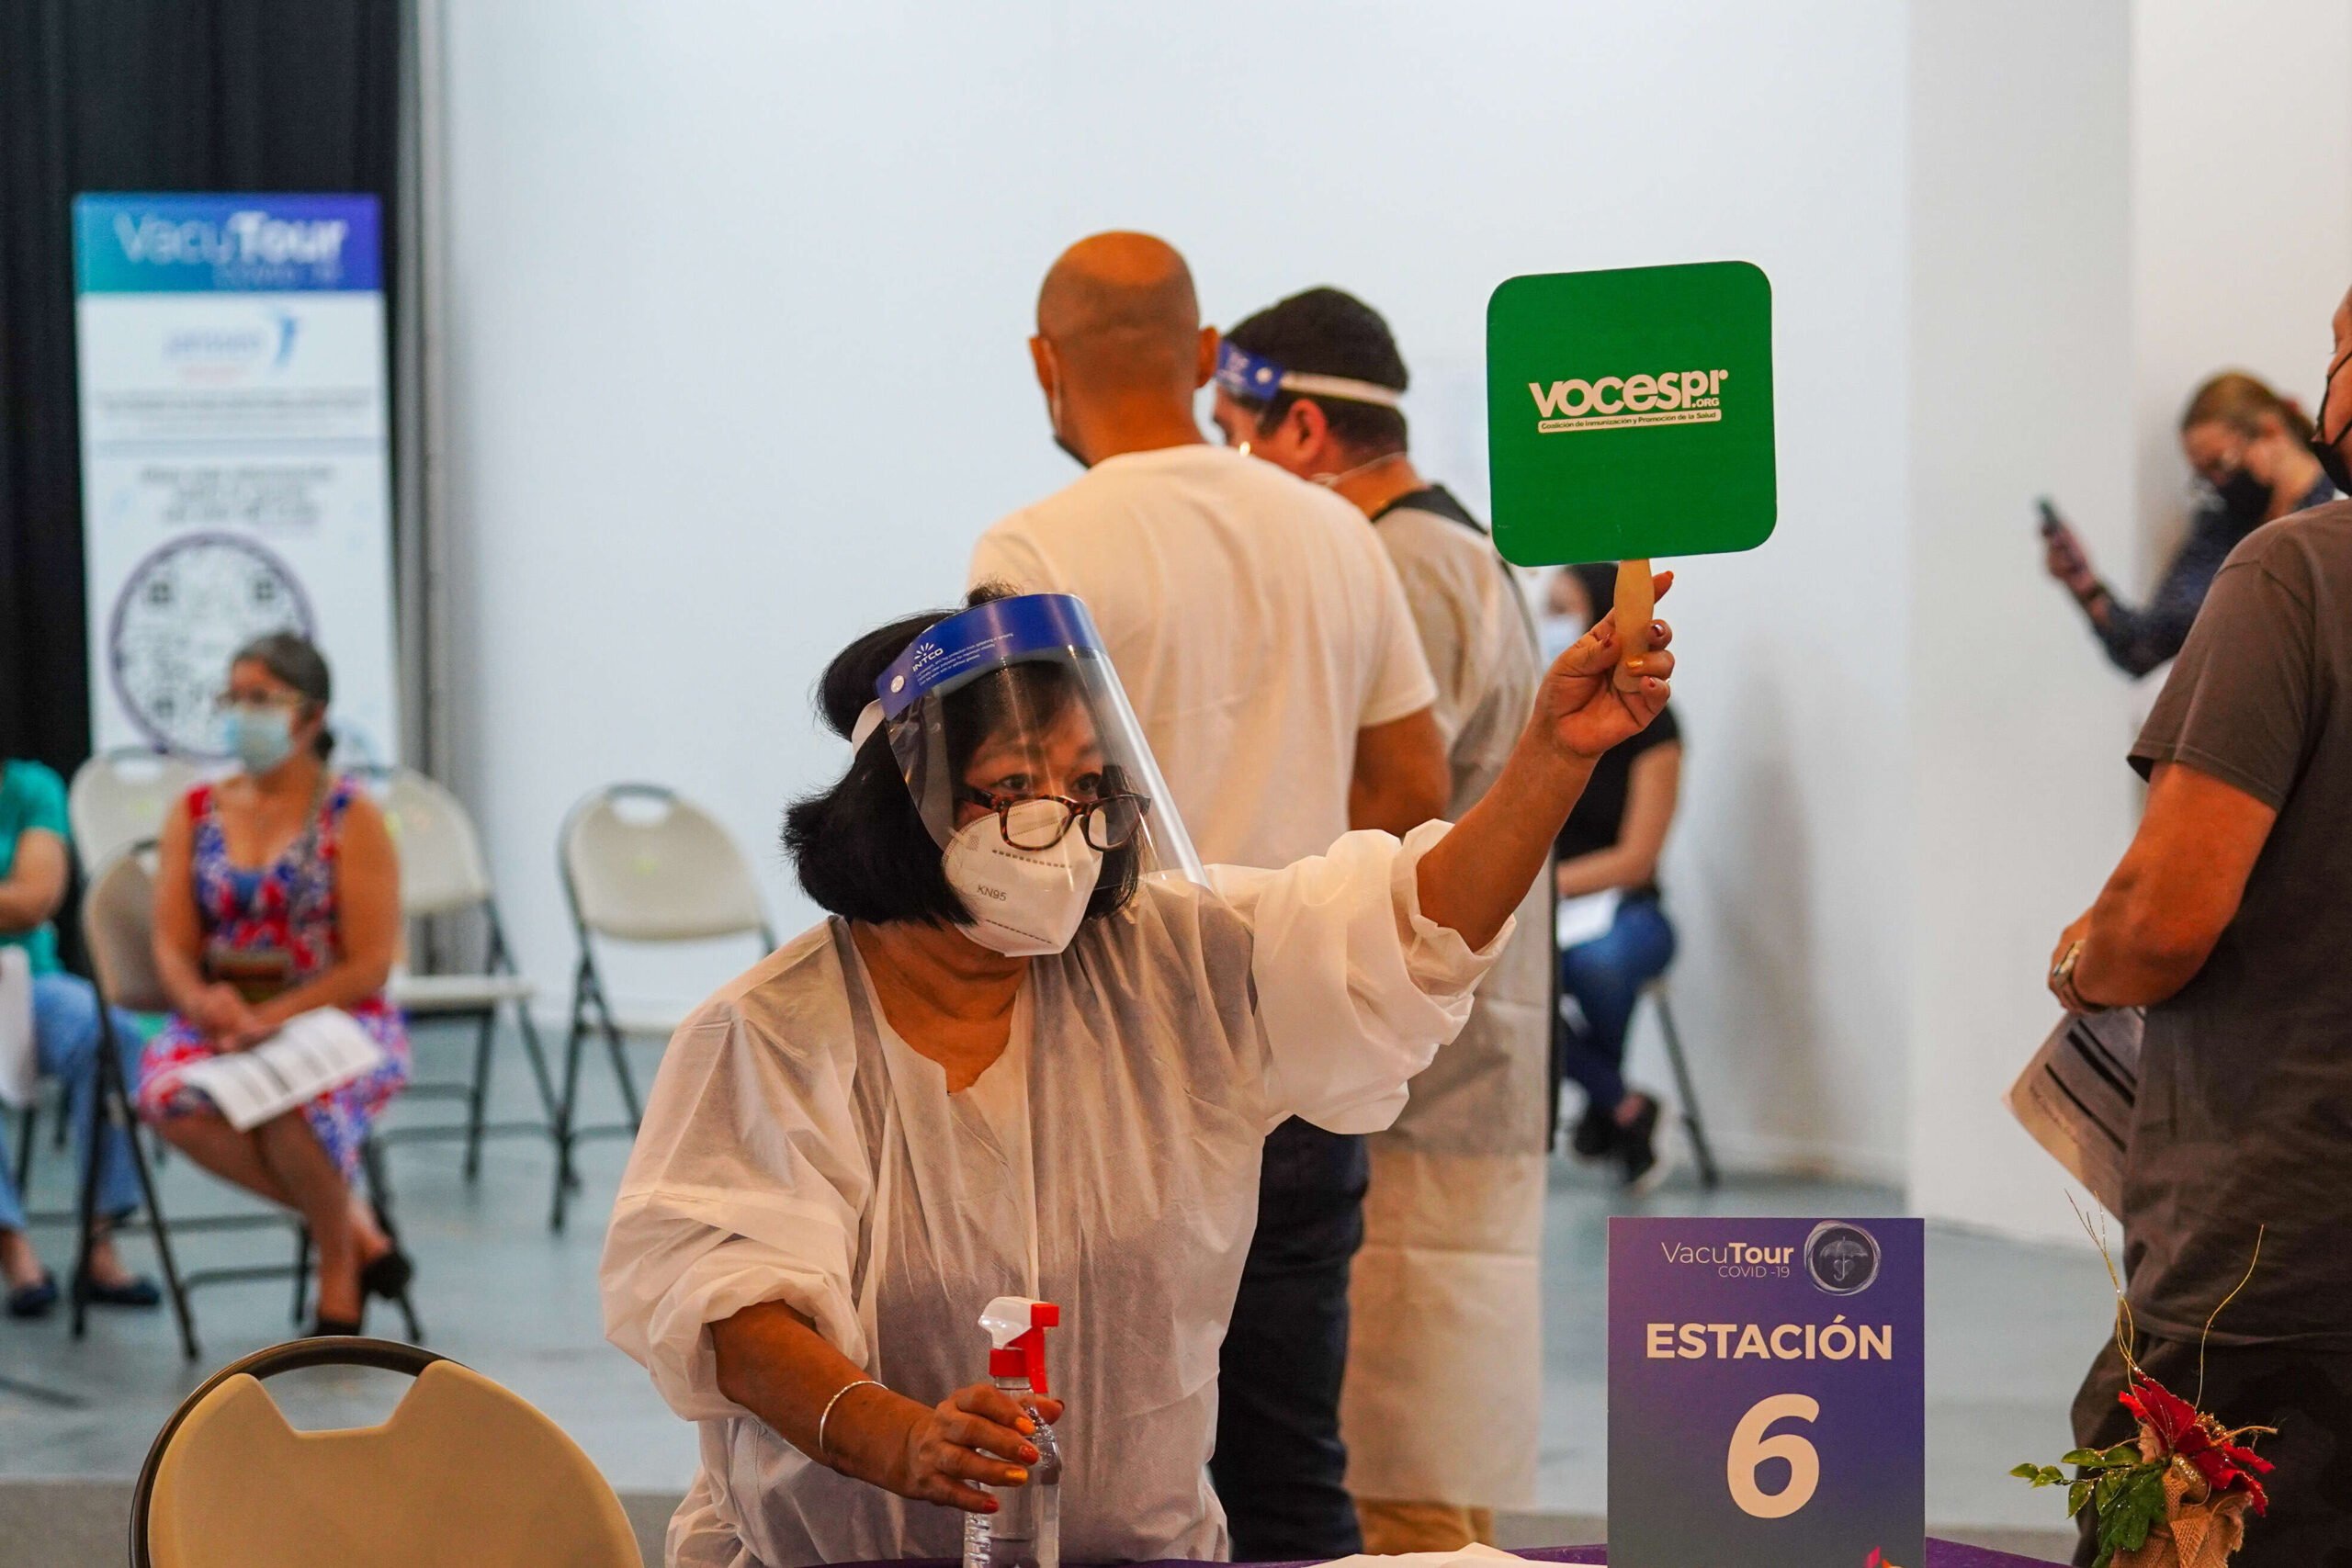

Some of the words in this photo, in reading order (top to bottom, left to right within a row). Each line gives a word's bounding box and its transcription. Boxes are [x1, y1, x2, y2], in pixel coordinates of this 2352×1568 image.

[1529, 369, 1729, 418] vocespr
[1541, 422, 1574, 430] Coalición
[1585, 417, 1632, 426] Inmunización
[1638, 414, 1676, 423] Promoción
[912, 648, 944, 671] INTCO
[977, 885, 1007, 901] KN95
[1661, 1242, 1795, 1264] VacuTour
[1718, 1266, 1767, 1278] COVID
[1647, 1314, 1892, 1359] ESTACIÓN
[1727, 1393, 1820, 1518] 6
